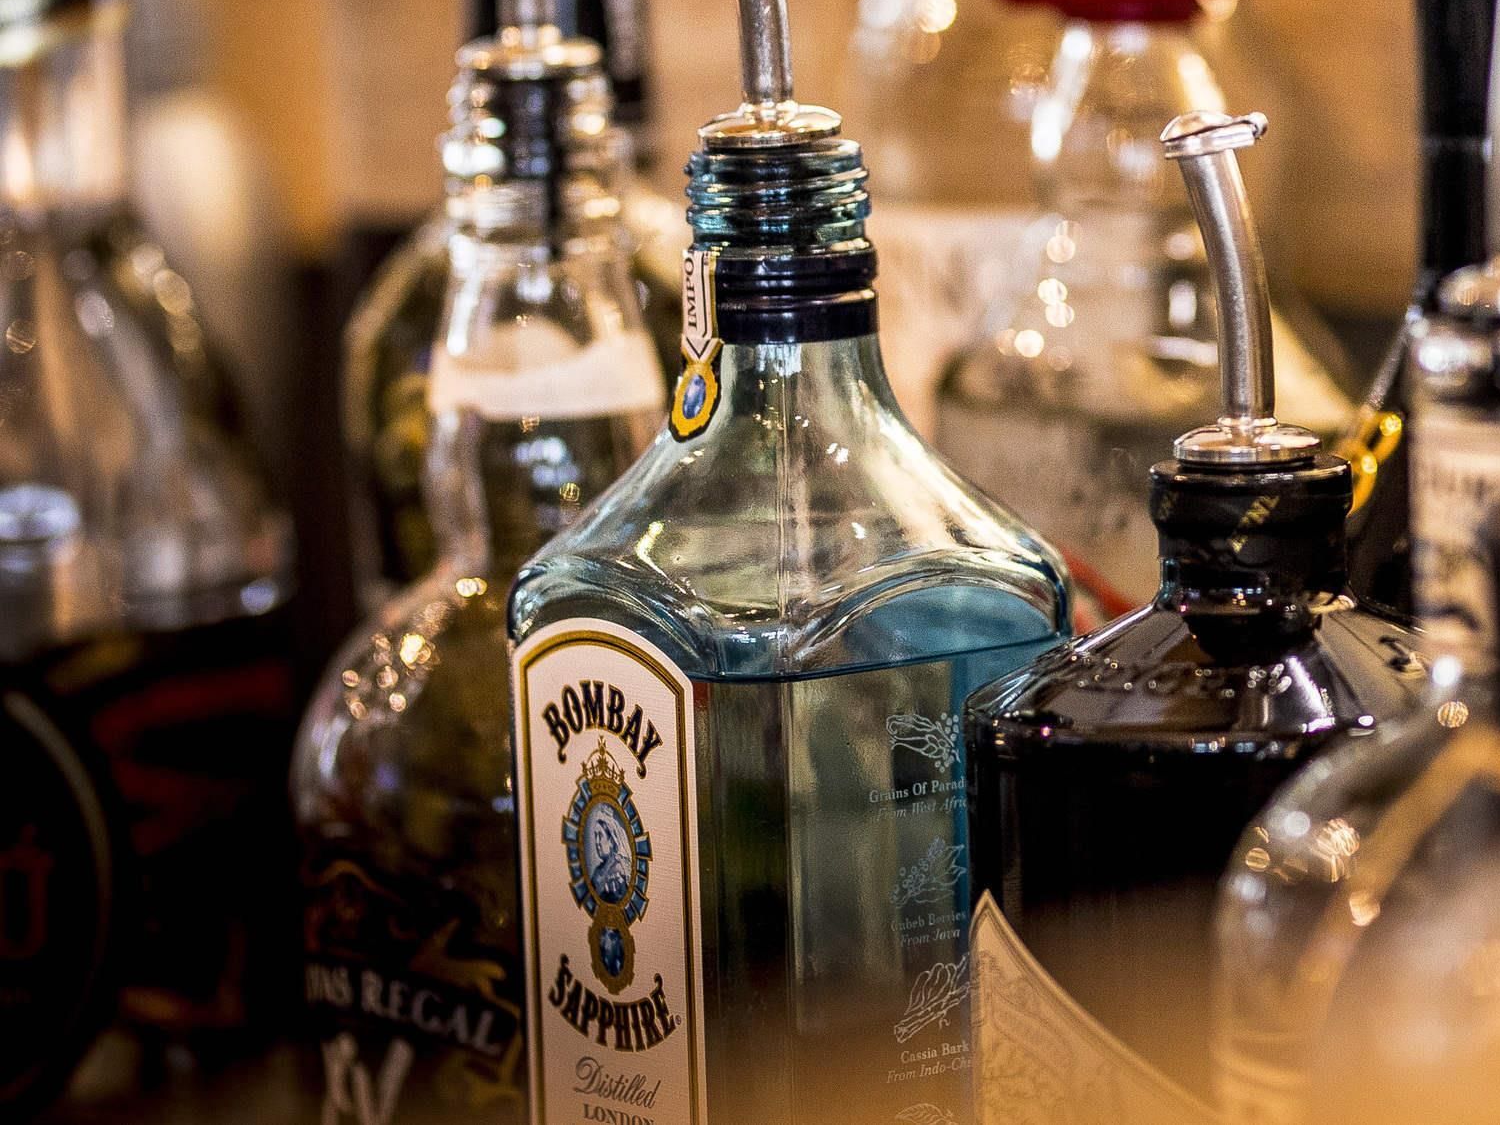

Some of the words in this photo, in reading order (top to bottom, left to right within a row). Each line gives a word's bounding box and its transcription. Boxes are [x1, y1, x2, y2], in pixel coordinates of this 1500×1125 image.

[684, 257, 697, 330] IMPO
[542, 679, 663, 779] BOMBAY
[869, 788, 909, 803] Grains
[912, 782, 927, 795] Of
[900, 933, 929, 947] From
[932, 928, 960, 941] Java
[361, 969, 501, 1055] REGAL
[548, 953, 677, 1053] SAPPHIRE
[886, 1070, 916, 1084] From
[901, 1048, 938, 1064] Cassia
[941, 1039, 970, 1056] Bark
[573, 1056, 662, 1109] Distilled
